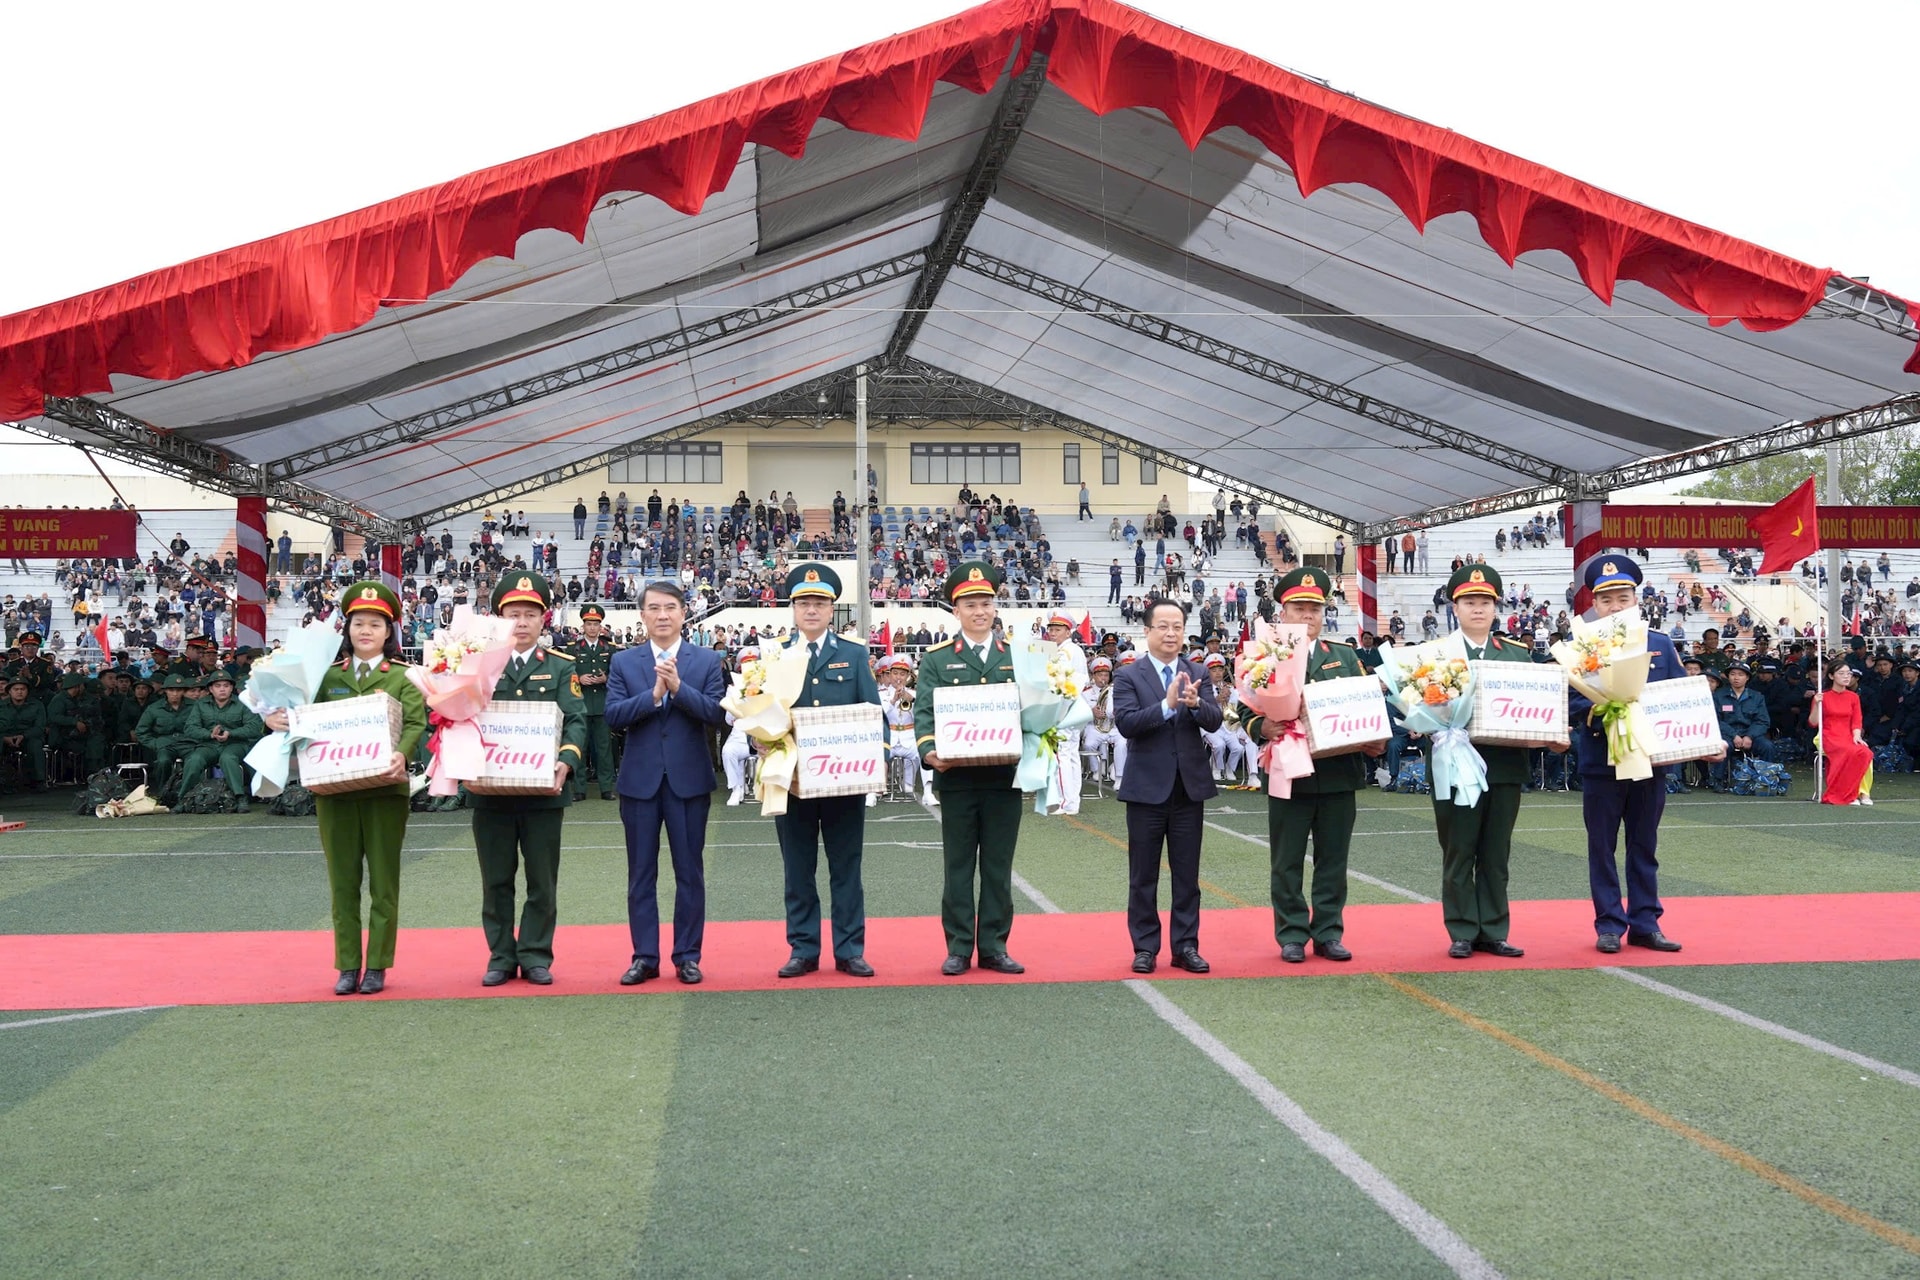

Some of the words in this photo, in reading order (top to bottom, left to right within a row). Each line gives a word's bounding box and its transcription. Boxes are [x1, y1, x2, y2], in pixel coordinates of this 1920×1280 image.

[13, 519, 60, 532] VANG
[1602, 517, 1621, 538] INH
[1625, 515, 1642, 543] DỰ
[1645, 515, 1661, 543] TỰ
[1664, 513, 1688, 539] HÀO
[1692, 513, 1705, 539] LÀ
[1710, 513, 1747, 539] NGƯỜI
[1851, 514, 1885, 541] QUÂN
[1888, 514, 1908, 544] ĐỘI
[13, 536, 50, 554] VIỆT
[1483, 680, 1502, 689] UBND
[935, 703, 953, 714] UBND
[1308, 699, 1326, 710] UBND
[1491, 697, 1554, 724] Tặng
[942, 721, 1013, 747] Tặng
[1320, 714, 1382, 737] Tặng
[1654, 720, 1710, 743] Tặng
[306, 740, 380, 766] Tặng
[798, 737, 817, 748] UBND
[483, 742, 546, 770] Tặng
[807, 754, 876, 780] Tặng
